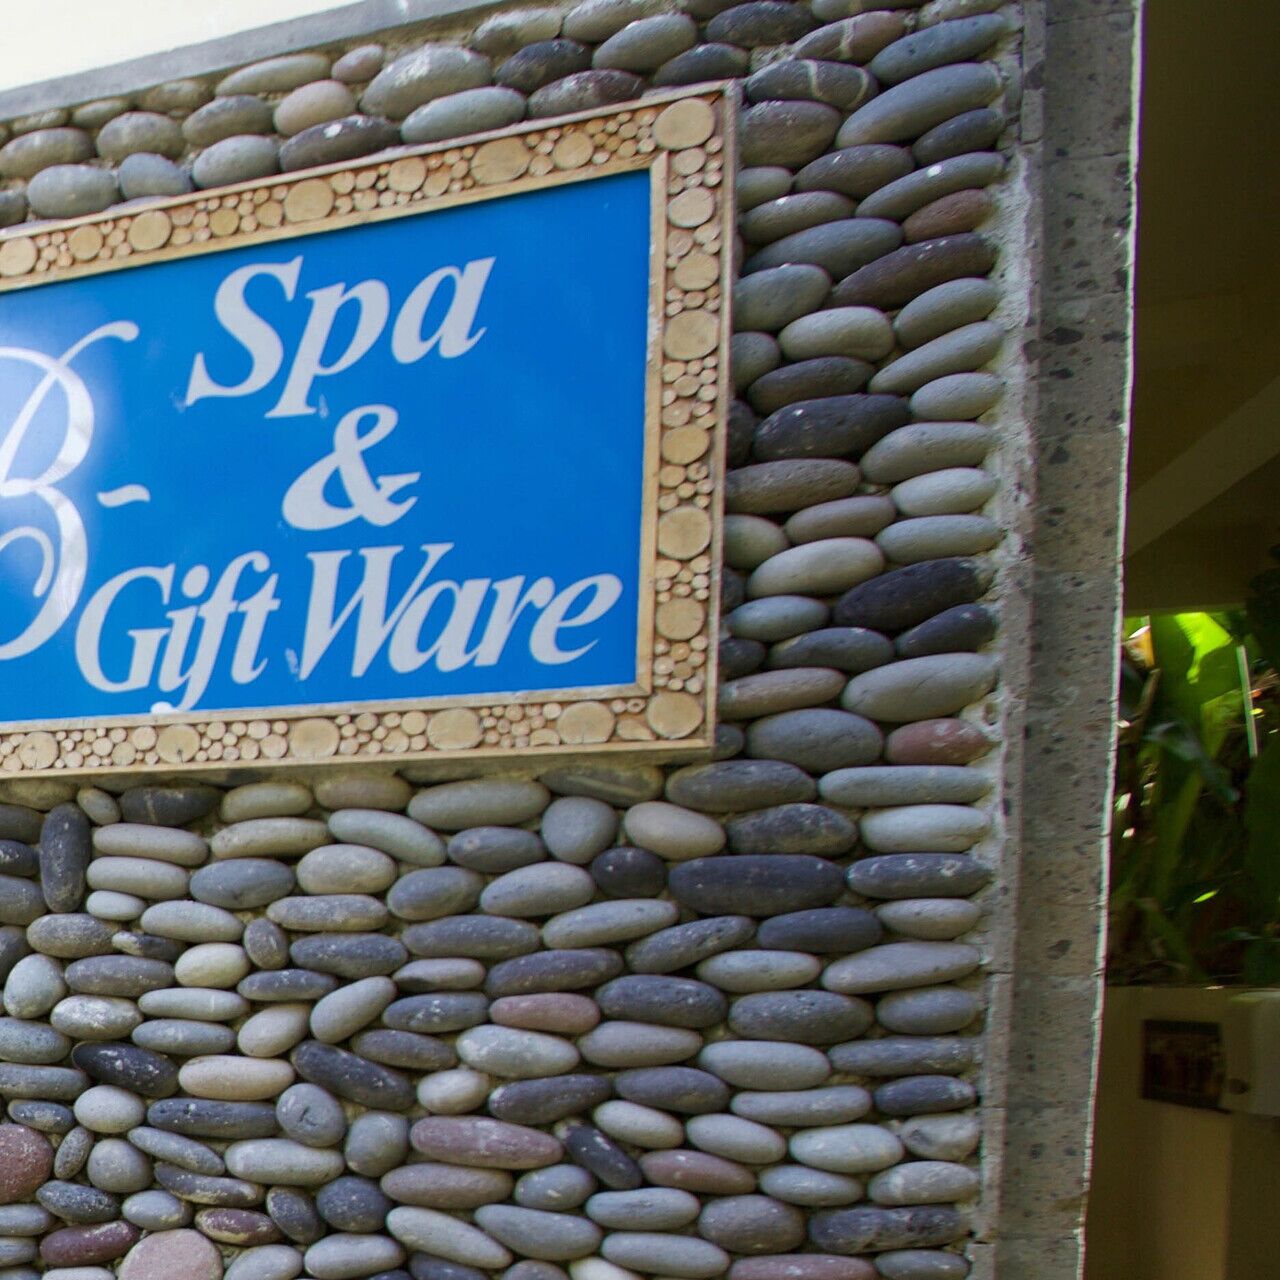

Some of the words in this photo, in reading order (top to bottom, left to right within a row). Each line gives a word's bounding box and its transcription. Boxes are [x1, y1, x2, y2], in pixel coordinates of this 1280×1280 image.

[185, 256, 496, 419] Spa
[282, 404, 422, 531] &
[75, 550, 281, 714] Gift
[296, 542, 623, 682] Ware
